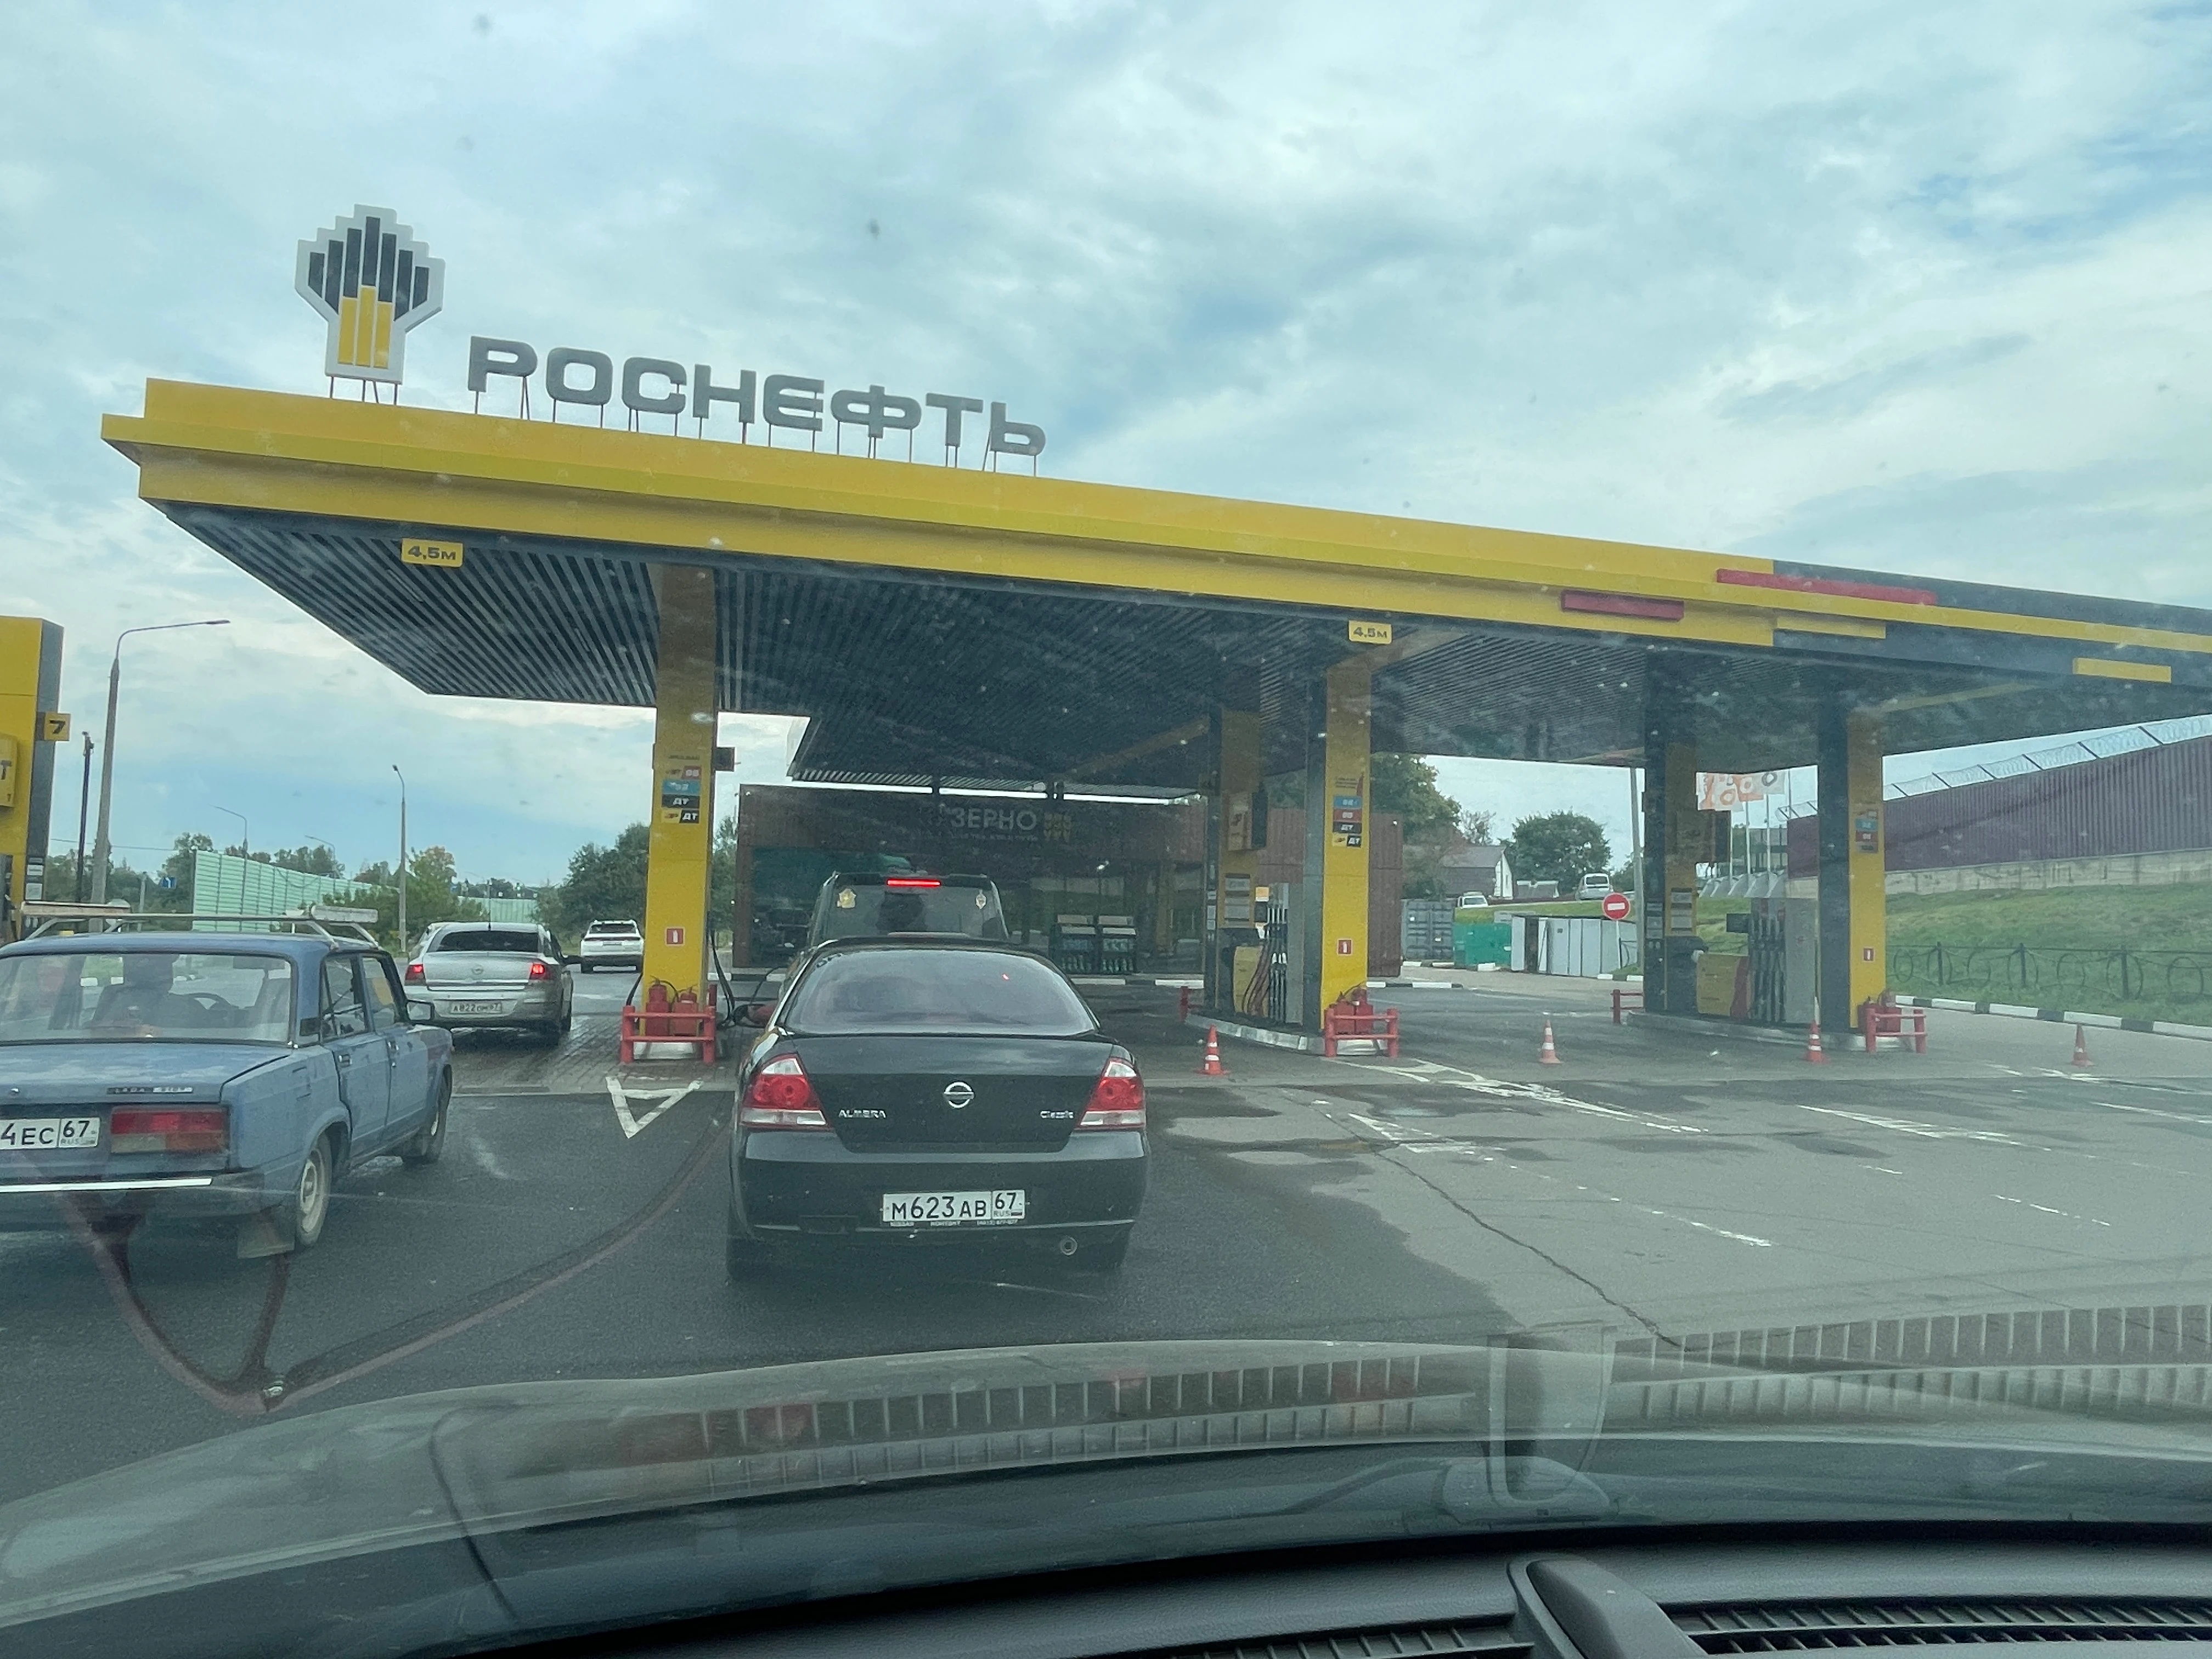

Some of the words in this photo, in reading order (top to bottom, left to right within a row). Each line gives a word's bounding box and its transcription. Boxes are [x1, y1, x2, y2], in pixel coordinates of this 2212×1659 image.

[468, 335, 1046, 456] РОСНЕФТЬ
[49, 720, 66, 734] 7
[682, 812, 698, 821] ДТ
[950, 807, 1037, 831] ЗЕРНО
[63, 1120, 90, 1138] 67
[892, 1196, 987, 1220] М623АВ
[995, 1192, 1018, 1210] 67
